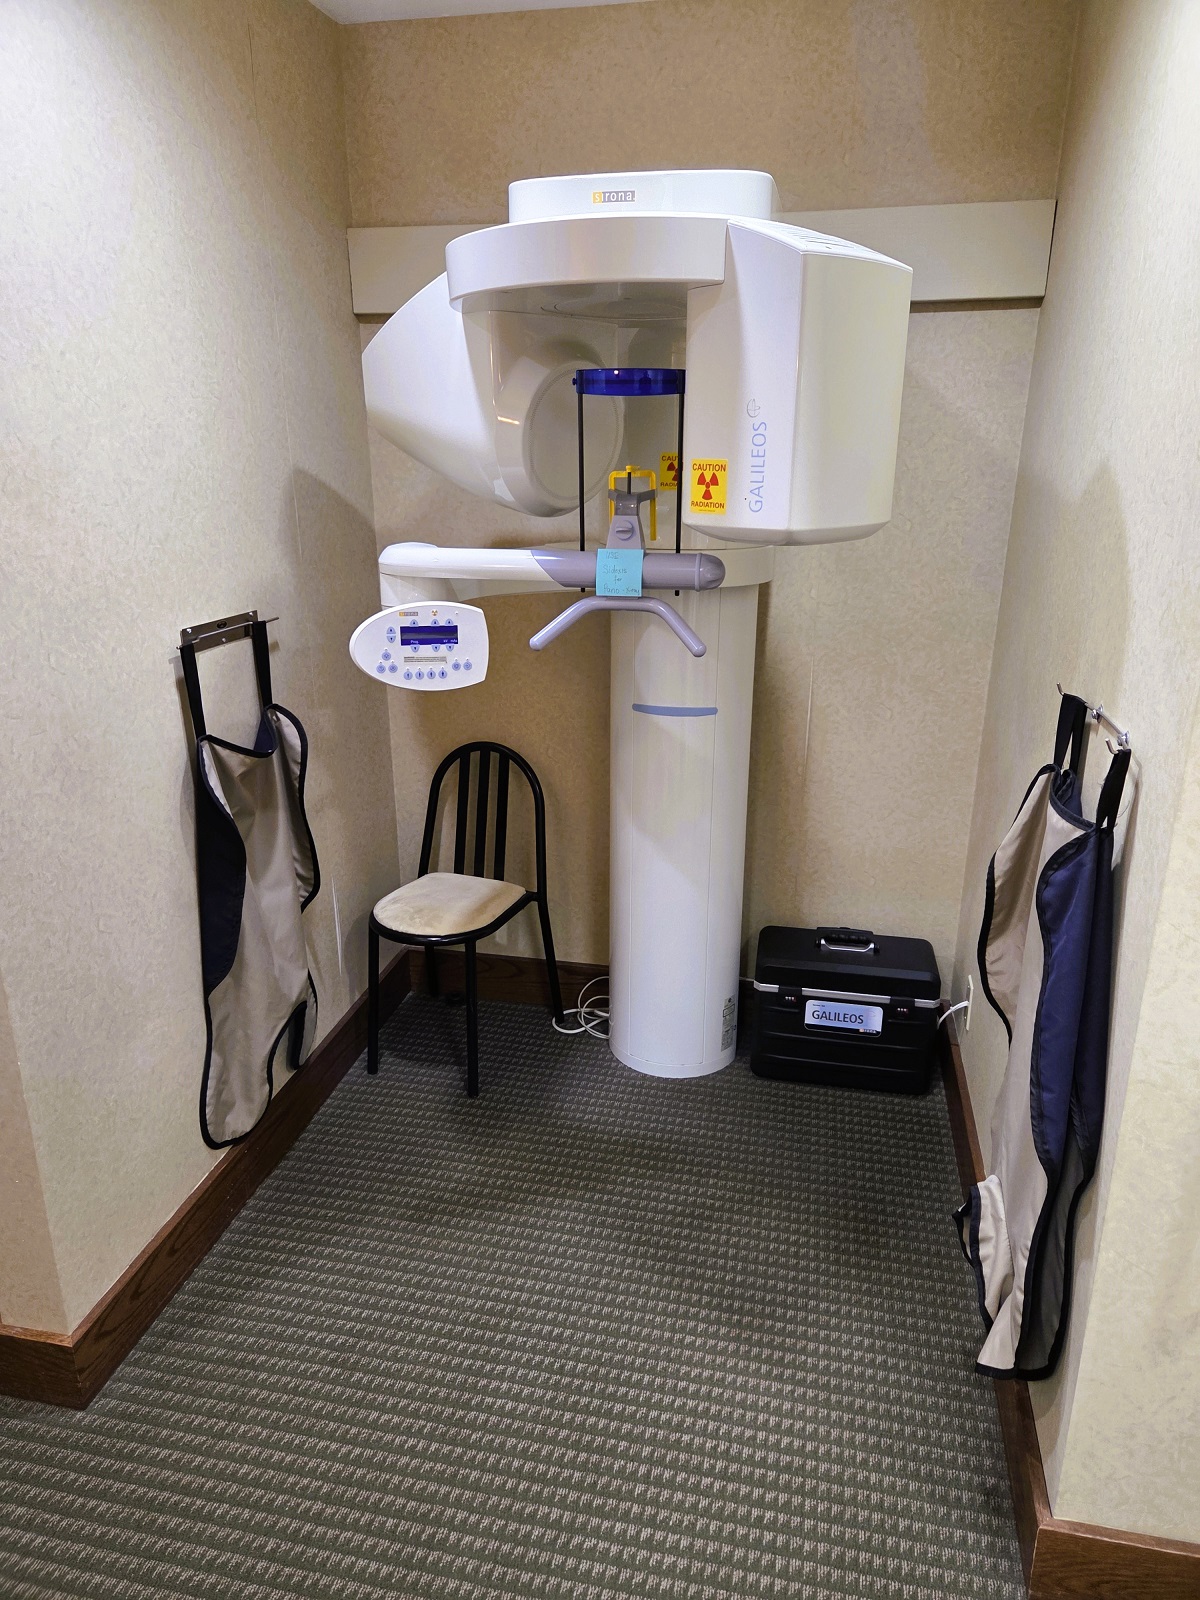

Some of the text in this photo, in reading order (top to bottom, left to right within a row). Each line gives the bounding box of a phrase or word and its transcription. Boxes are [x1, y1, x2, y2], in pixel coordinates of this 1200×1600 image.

[692, 463, 726, 472] CAUTION
[748, 421, 767, 513] GALILEOS
[691, 501, 725, 509] RADIATION
[812, 1010, 864, 1025] GALILEOS
